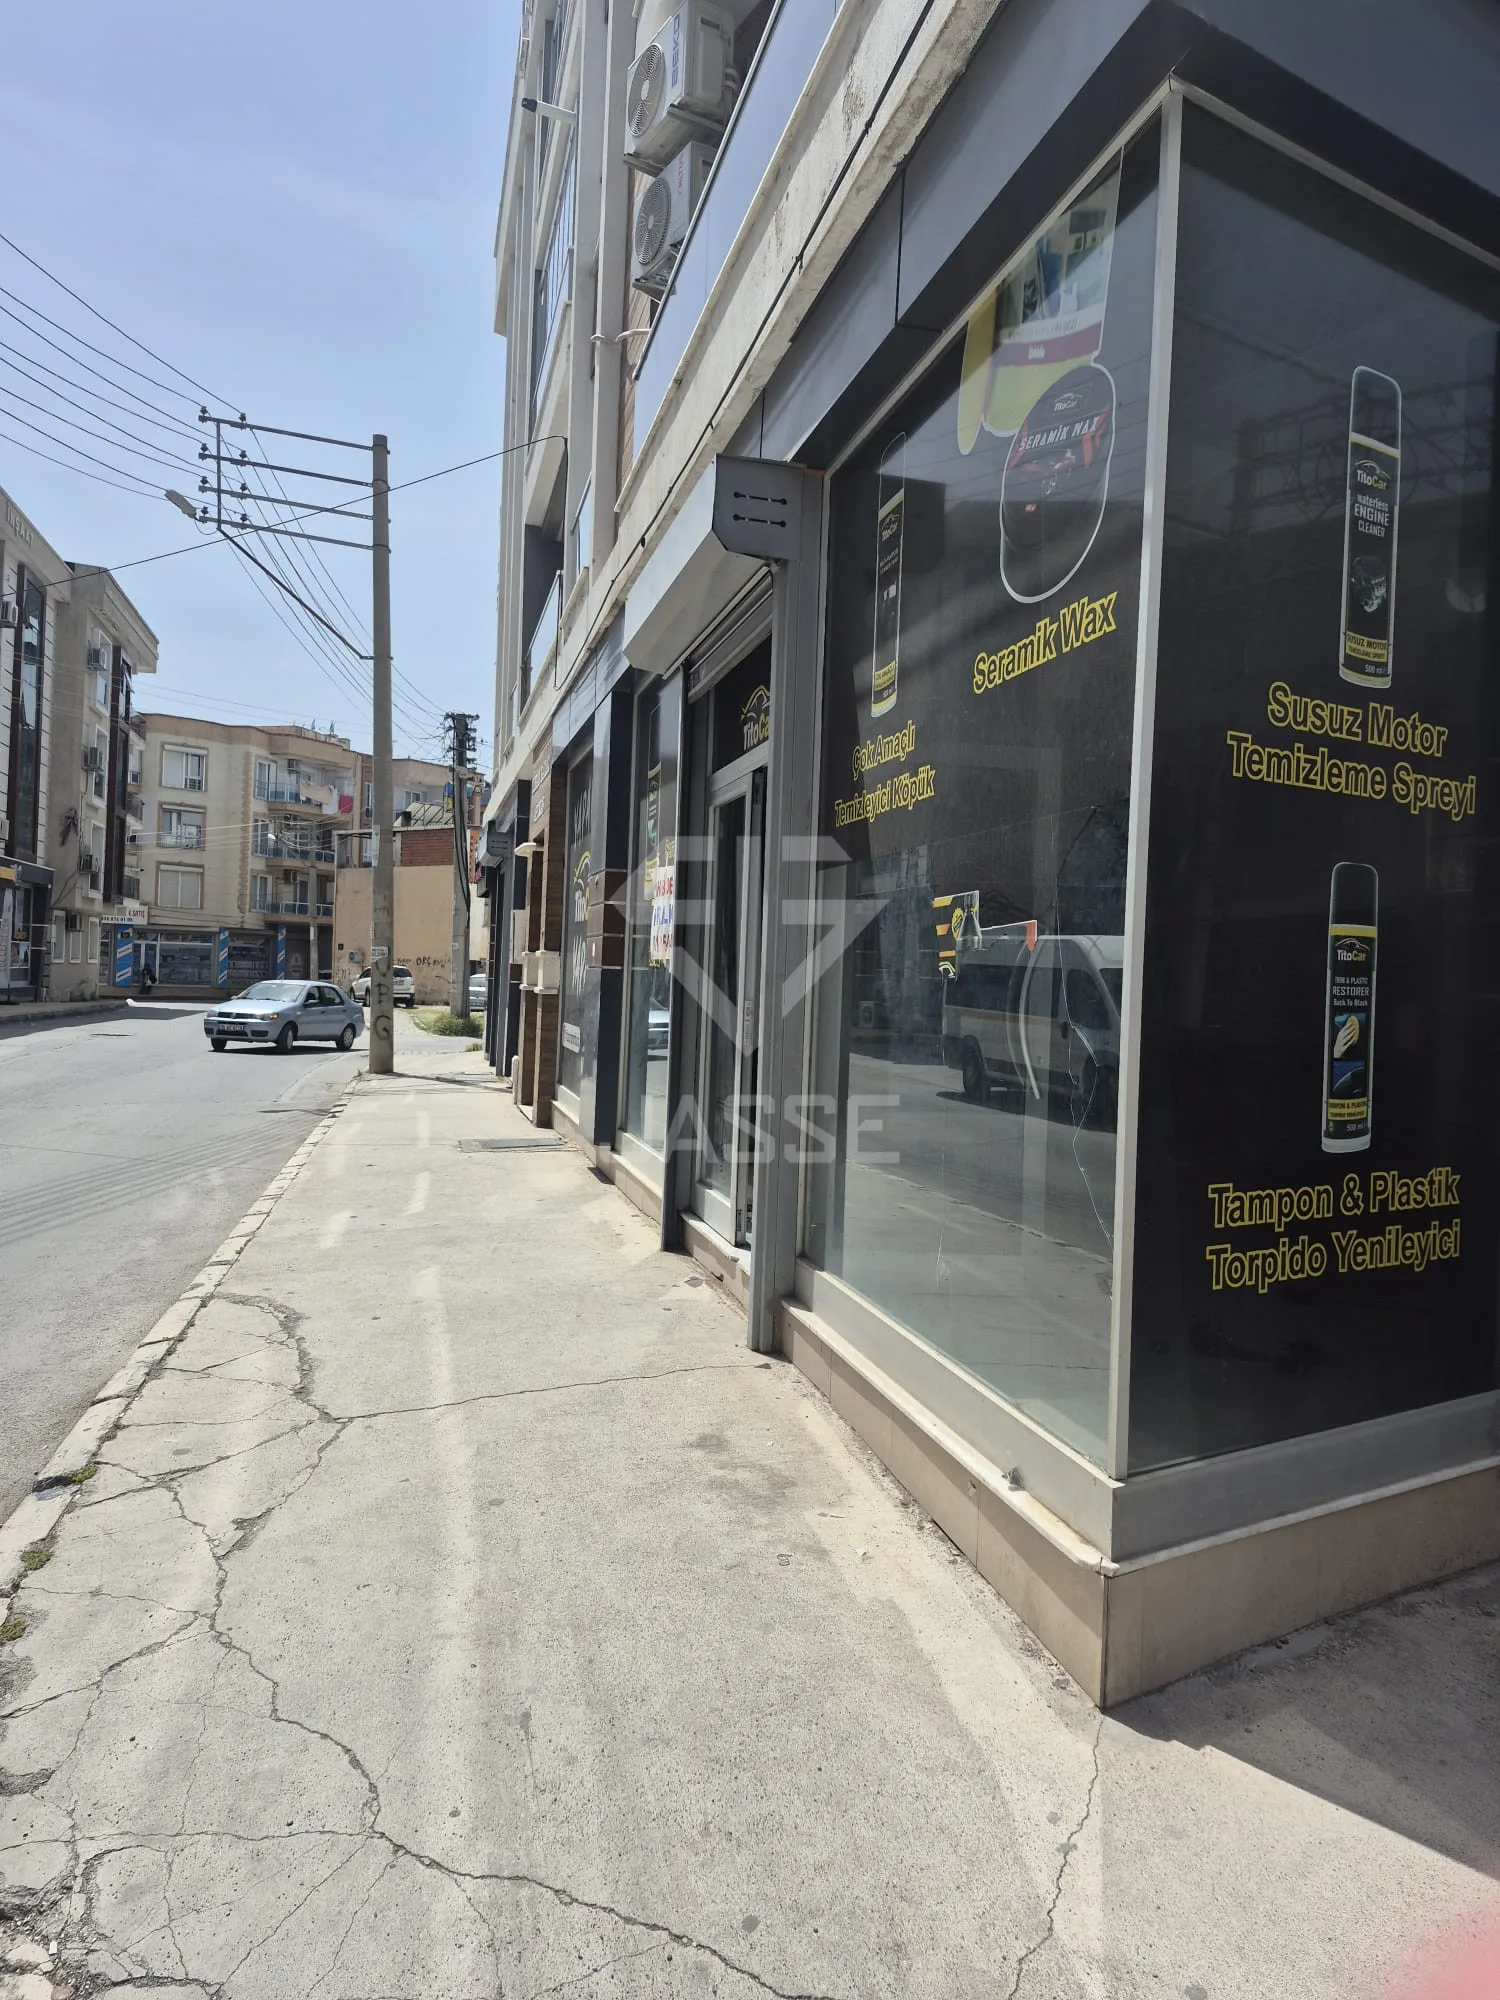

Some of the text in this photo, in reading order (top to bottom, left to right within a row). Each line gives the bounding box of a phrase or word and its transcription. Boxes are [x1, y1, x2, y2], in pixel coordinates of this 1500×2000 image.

[671, 13, 680, 88] BEKO
[1071, 415, 1101, 437] WAX
[1356, 468, 1388, 491] TitoCar
[1354, 504, 1390, 527] ENGINE
[1358, 520, 1386, 538] CLEANER
[973, 591, 1118, 695] Seramik Wax
[852, 719, 916, 781] Çok Amaçlı
[1267, 681, 1449, 757] Susuz Motor
[835, 764, 936, 828] Temizleyici Köpük
[1227, 730, 1477, 822] Temizleme Spreyi
[1337, 949, 1367, 962] TitoCar
[1332, 986, 1369, 996] RESTORER
[1208, 1166, 1461, 1232] Tampon & Plastik
[1206, 1218, 1461, 1294] Torpido Yenileyici
